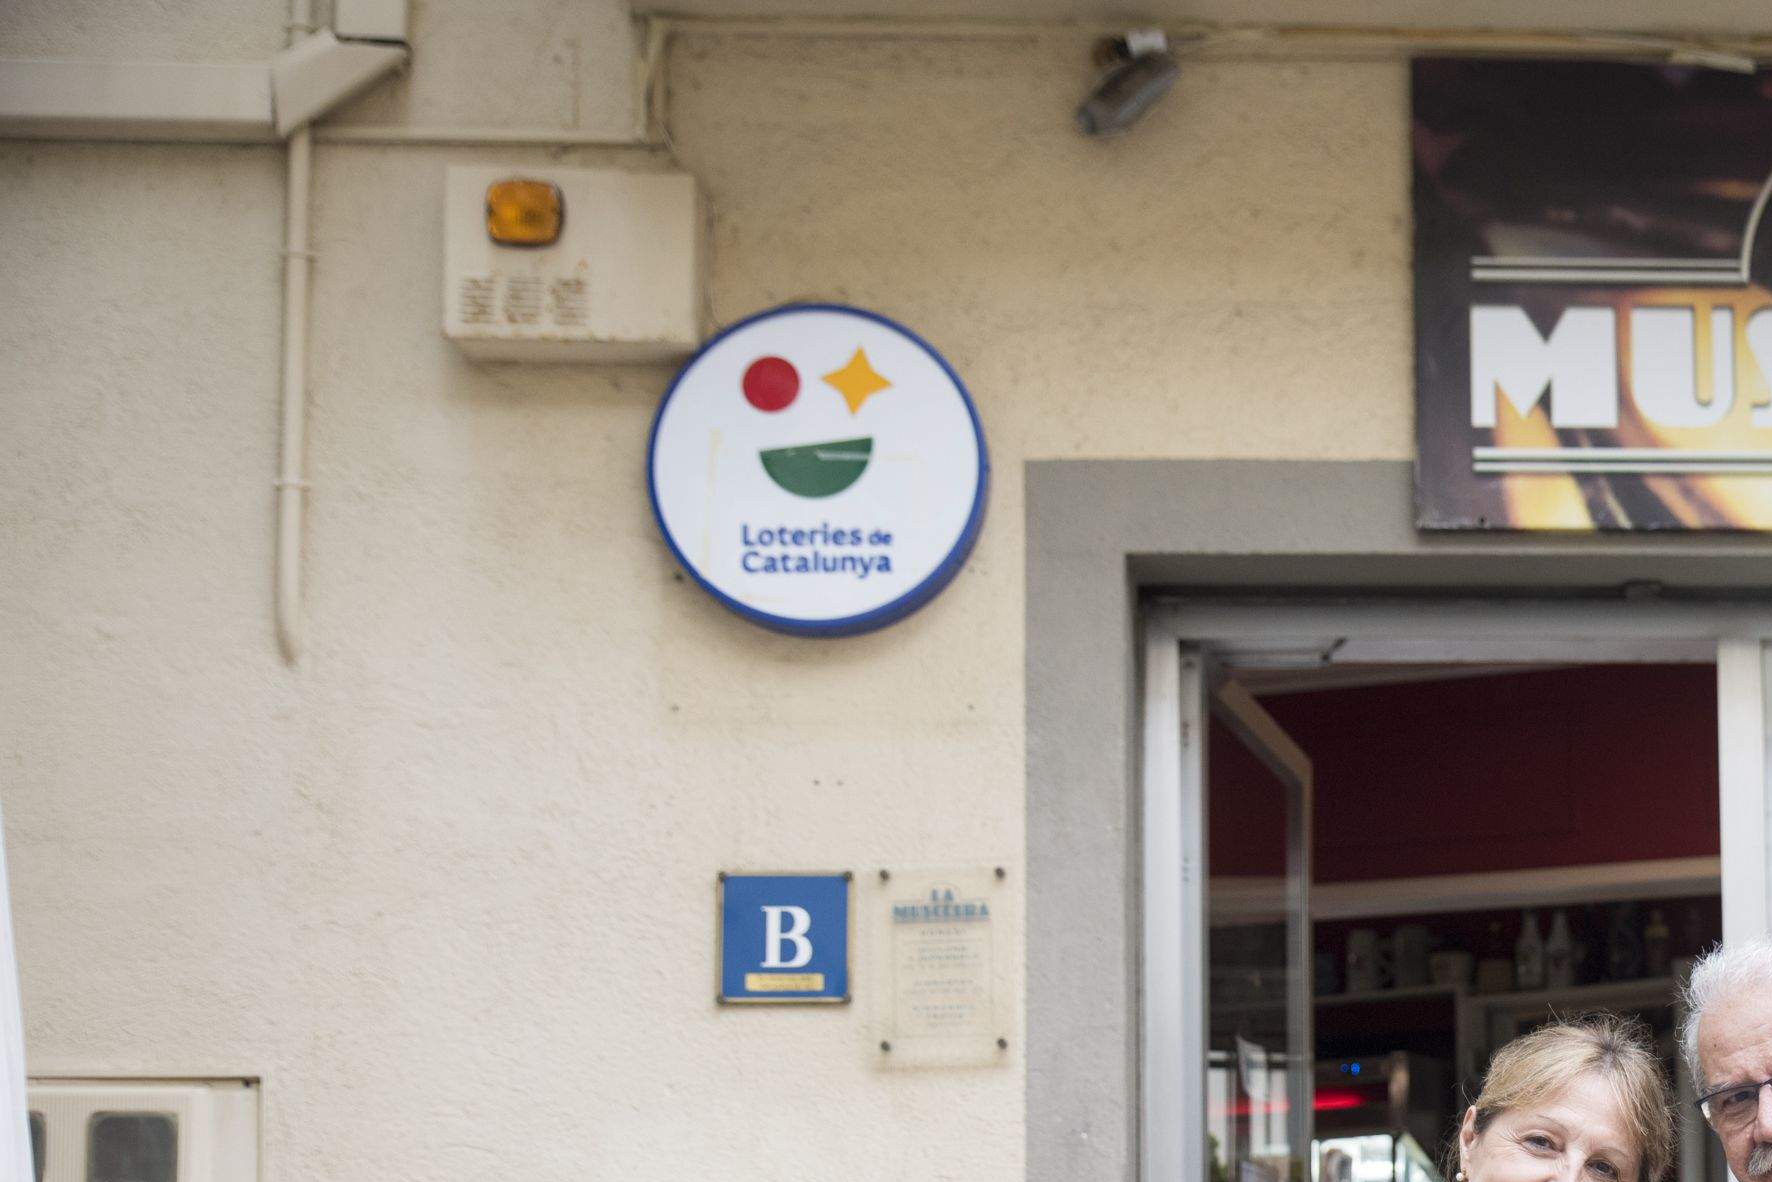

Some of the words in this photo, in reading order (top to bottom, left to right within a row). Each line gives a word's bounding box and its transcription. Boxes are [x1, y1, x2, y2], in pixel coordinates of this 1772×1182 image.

[741, 521, 863, 546] Loteries
[868, 528, 893, 545] de
[742, 551, 893, 579] Catalunya
[760, 905, 814, 968] B
